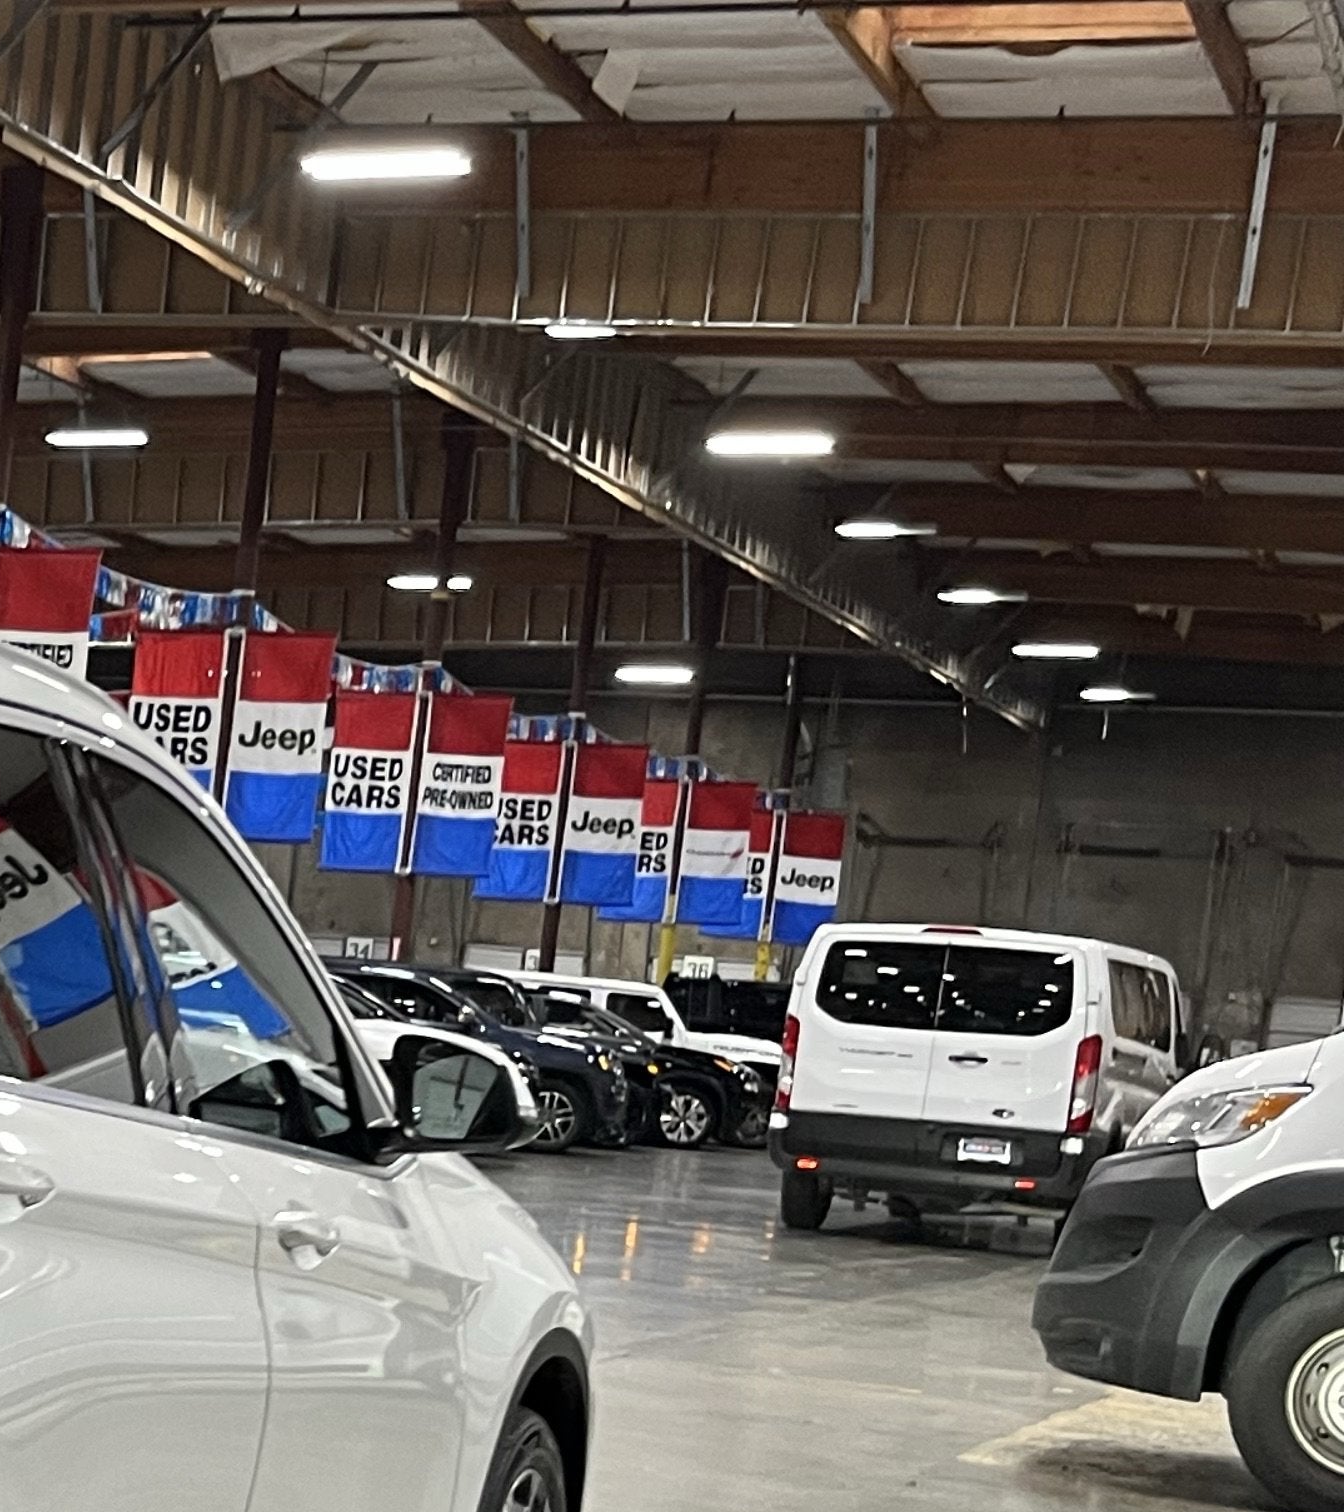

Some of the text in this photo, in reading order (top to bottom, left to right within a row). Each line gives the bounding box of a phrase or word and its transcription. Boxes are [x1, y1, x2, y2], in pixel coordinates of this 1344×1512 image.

[133, 703, 211, 733] USED
[154, 736, 209, 765] RS
[238, 720, 316, 755] Jeep
[334, 754, 403, 781] USED
[432, 762, 491, 784] CERTIFIED
[331, 782, 401, 809] CARS
[422, 787, 493, 810] PRE-OWNED
[494, 823, 549, 845] ARS
[571, 811, 635, 839] Jeep
[640, 832, 667, 851] ED
[637, 854, 666, 873] RS
[781, 868, 835, 893] Jeep
